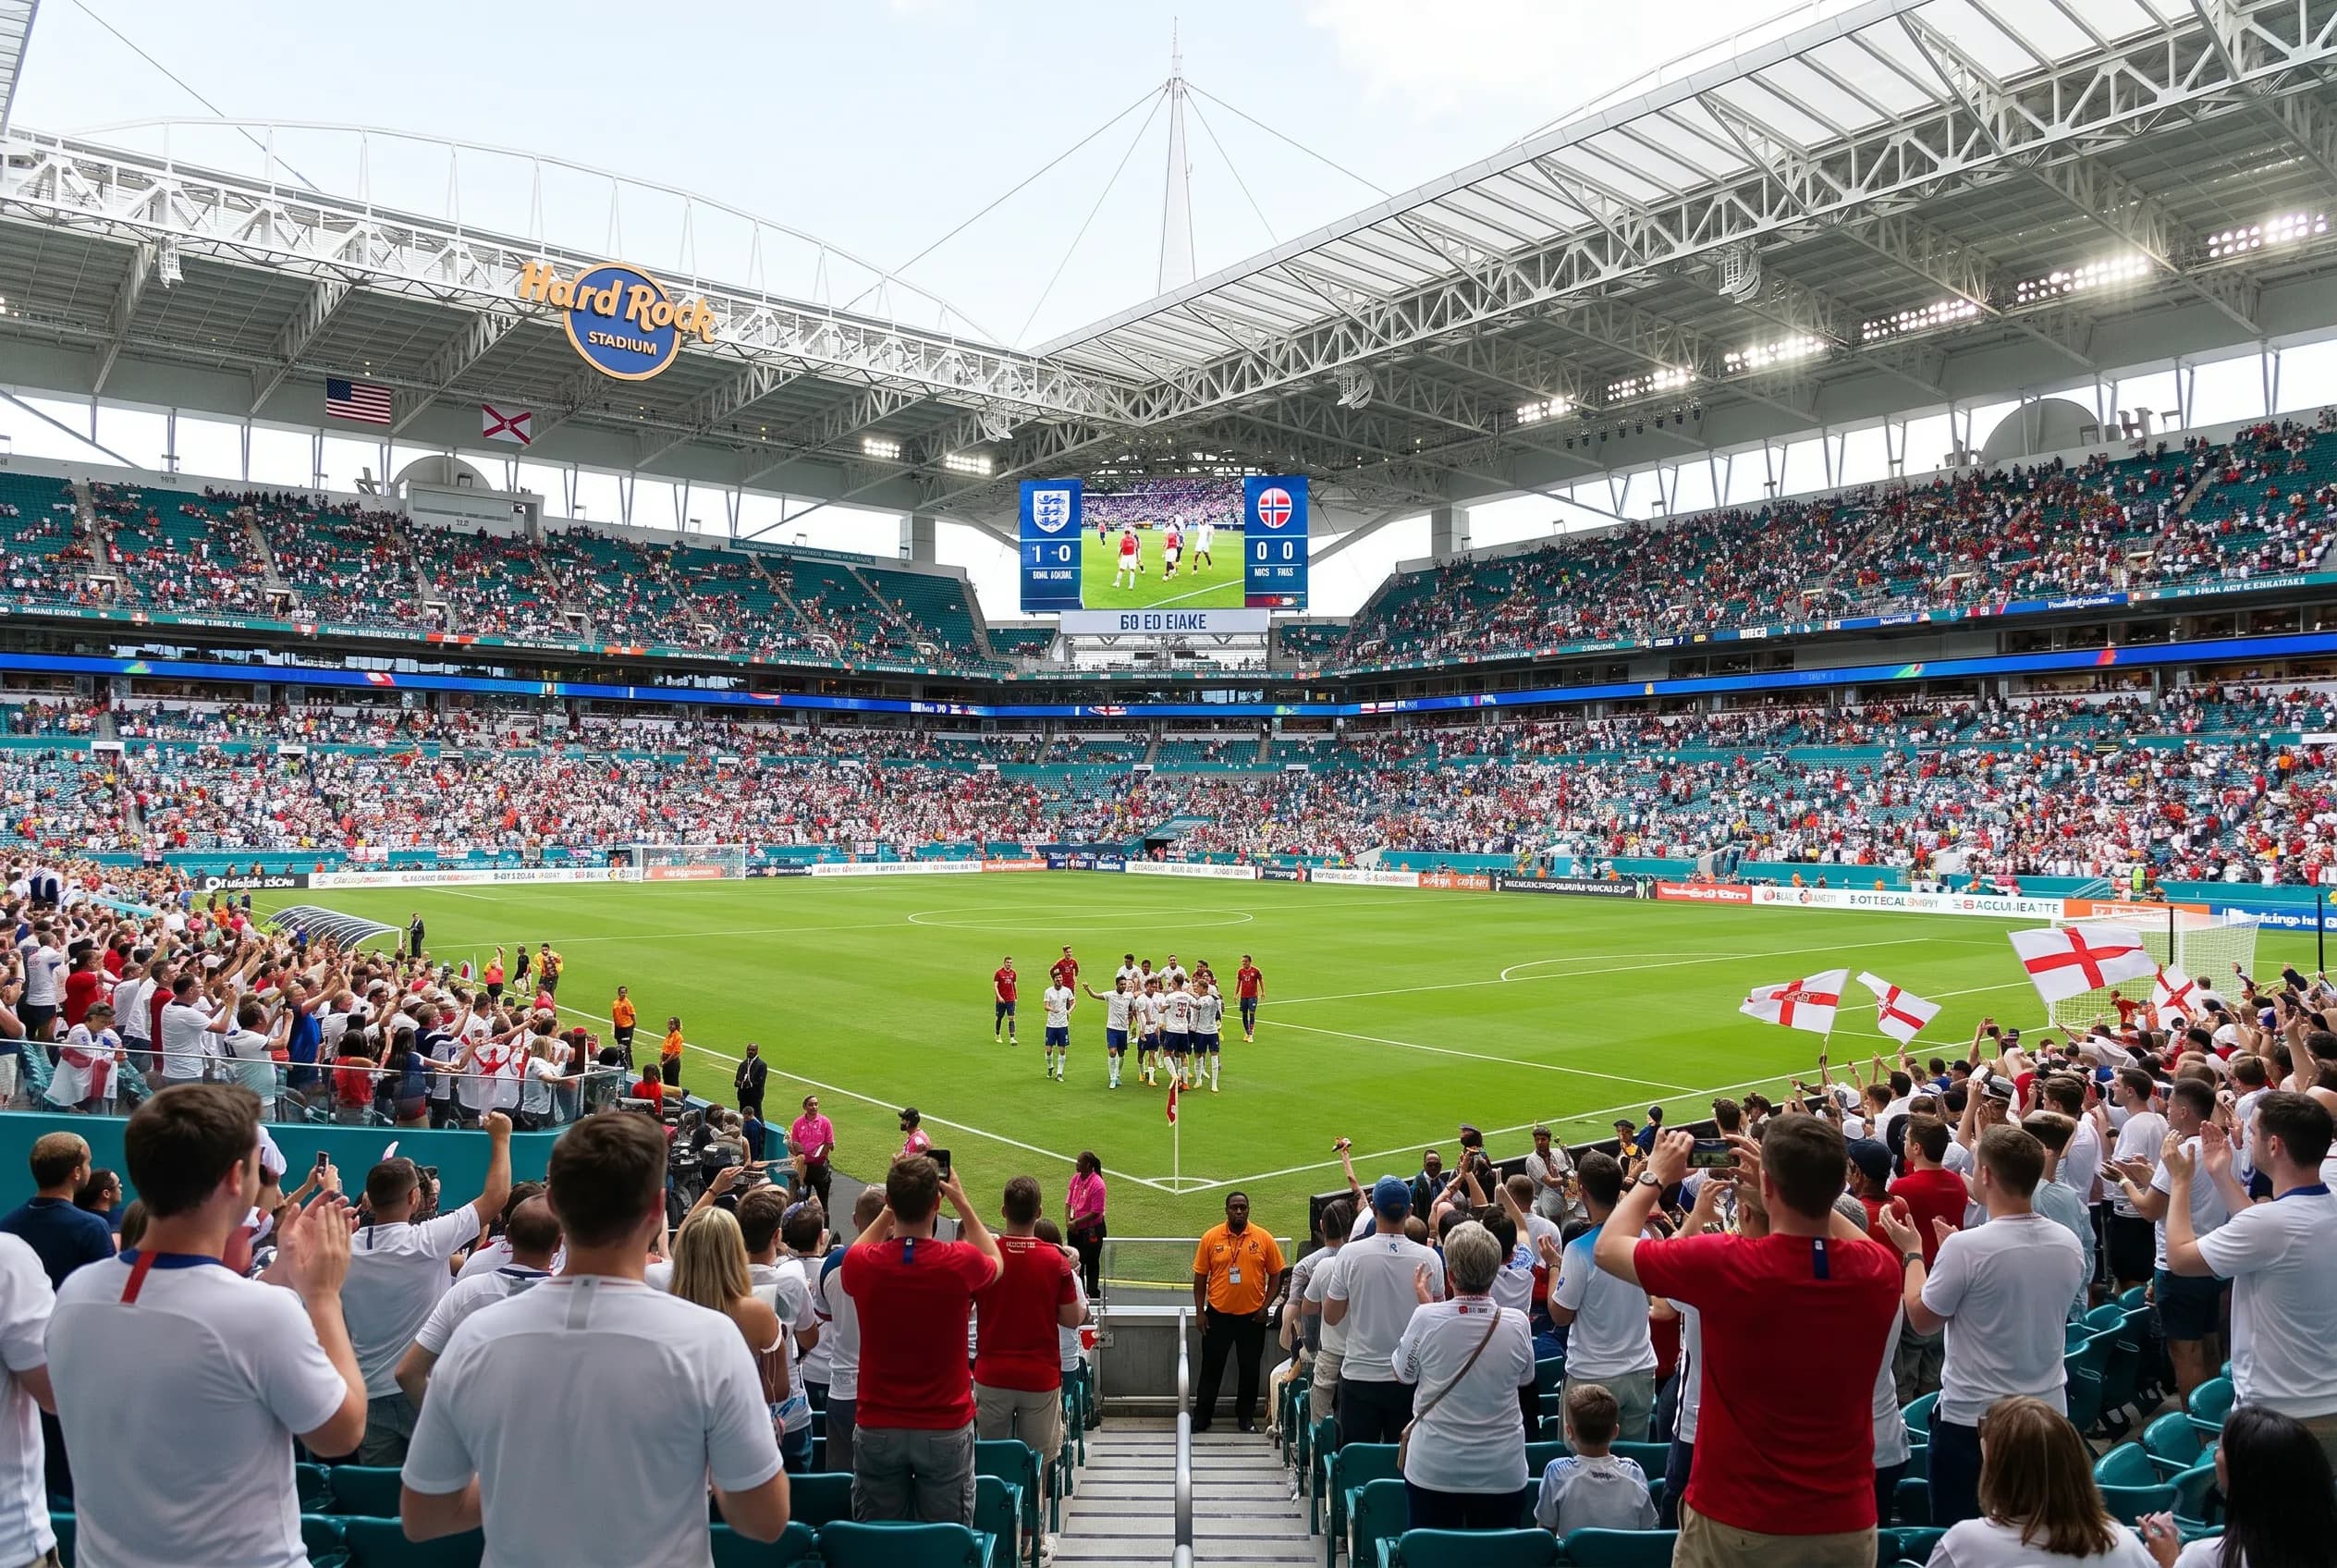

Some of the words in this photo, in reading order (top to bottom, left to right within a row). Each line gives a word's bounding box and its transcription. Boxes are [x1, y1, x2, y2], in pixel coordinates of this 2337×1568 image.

[519, 262, 624, 316] Hard
[626, 284, 716, 343] Rock
[588, 331, 657, 356] STADIUM
